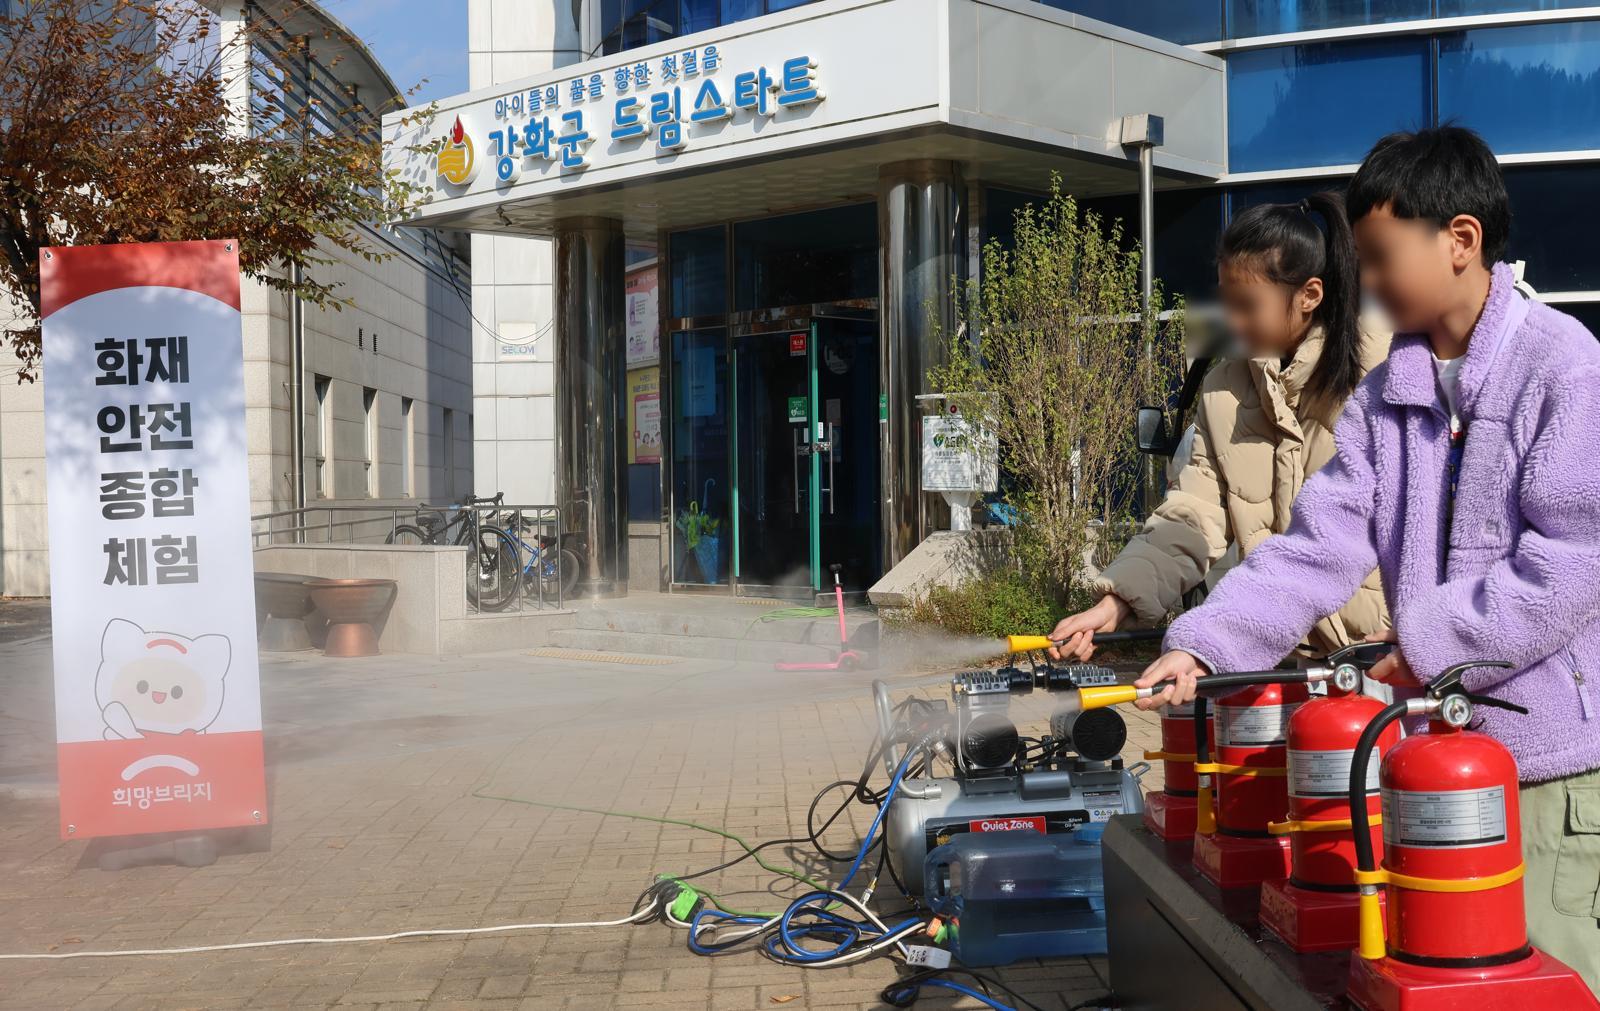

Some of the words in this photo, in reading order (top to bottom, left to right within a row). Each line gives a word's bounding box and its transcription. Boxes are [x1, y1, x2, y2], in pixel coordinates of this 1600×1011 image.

[495, 83, 559, 119] 아이들의
[570, 74, 604, 103] 꿈을
[614, 62, 651, 91] 향한
[662, 45, 720, 80] 첫걸음
[489, 110, 589, 182] 강화군
[611, 56, 818, 149] 드림스타트
[94, 335, 191, 387] 화재
[501, 345, 535, 355] SECOM
[96, 401, 194, 454] 안전
[99, 467, 200, 522] 종합
[103, 534, 200, 587] 체험
[112, 782, 212, 810] 희망브리지
[981, 821, 1009, 832] Quiet
[1010, 820, 1035, 830] Zone
